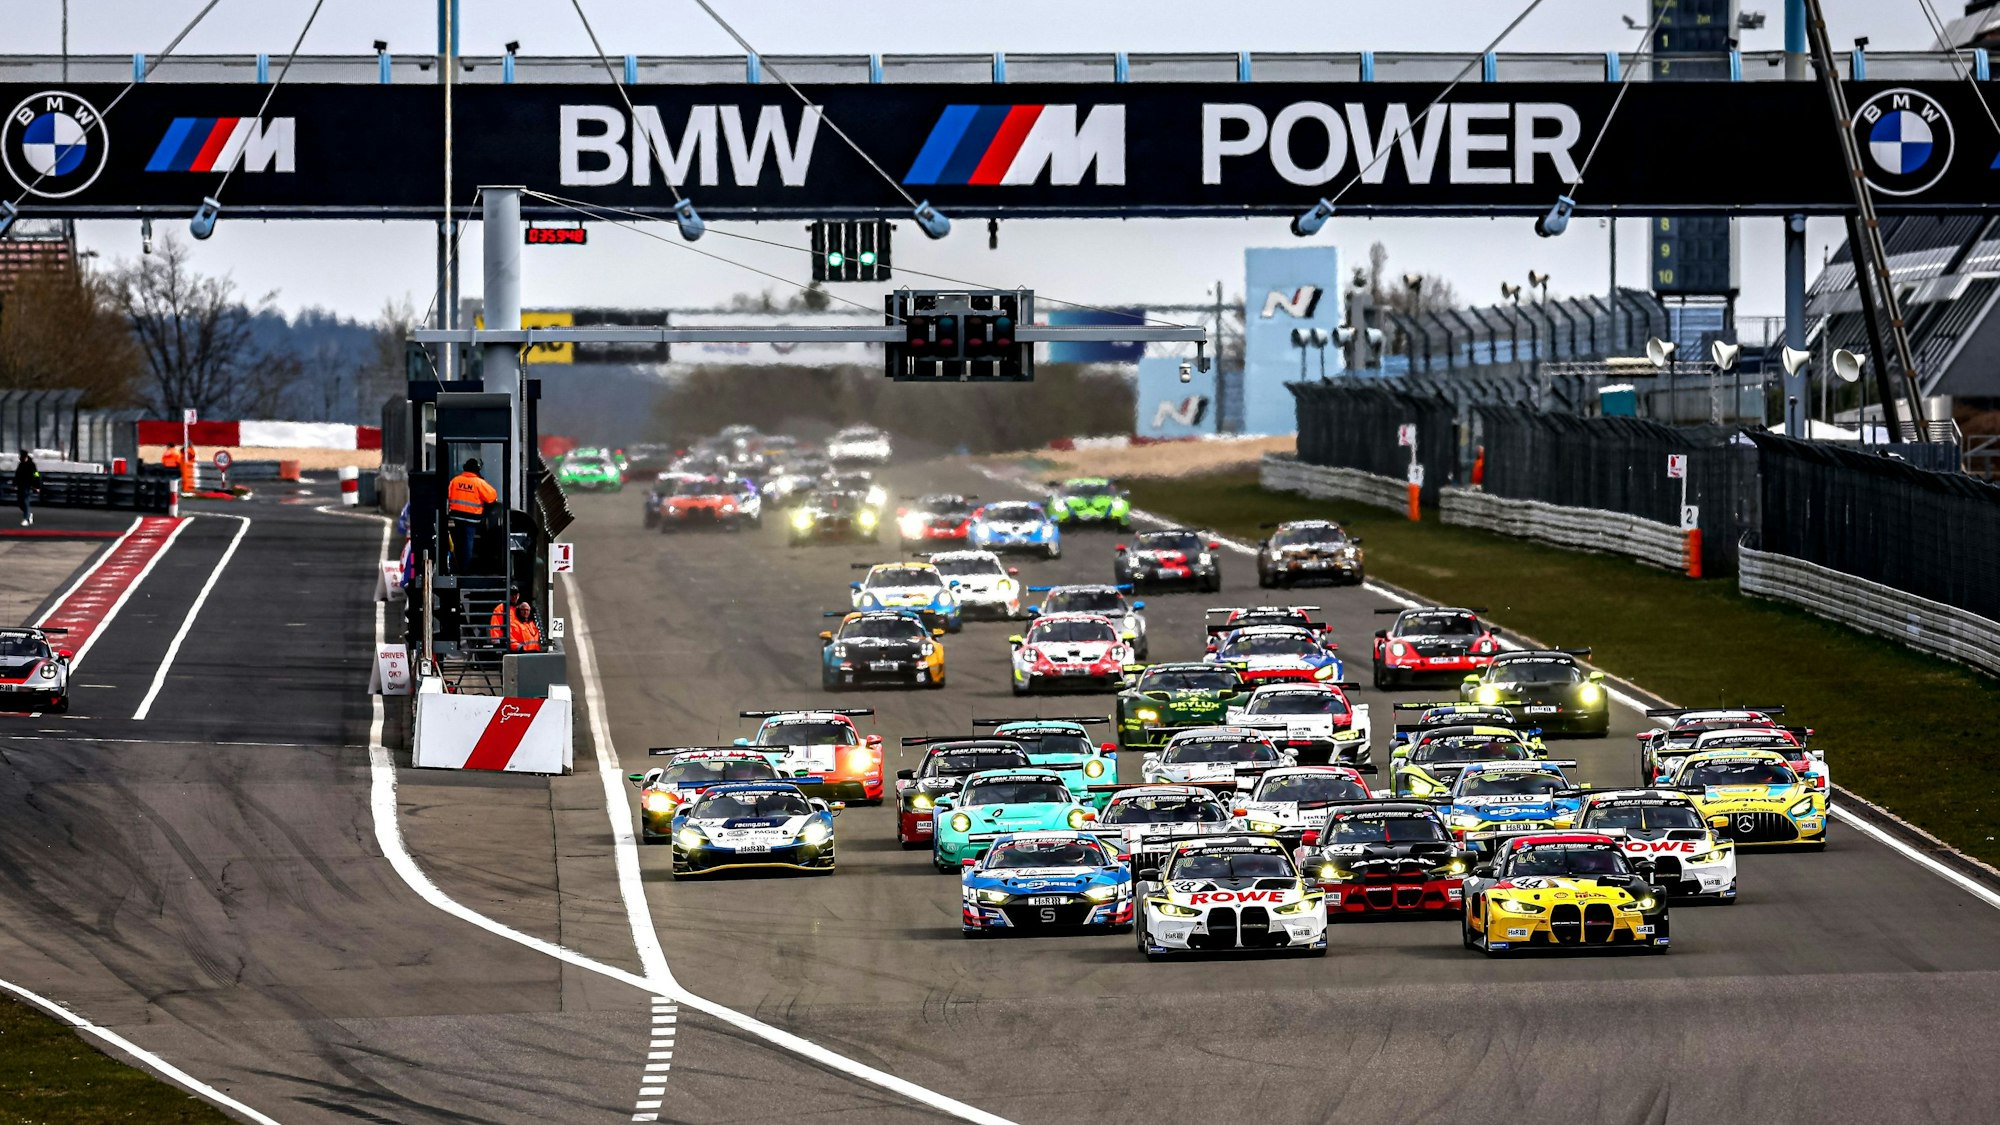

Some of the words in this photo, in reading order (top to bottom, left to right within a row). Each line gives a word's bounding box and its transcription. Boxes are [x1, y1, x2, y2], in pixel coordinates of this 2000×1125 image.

[16, 97, 94, 126] BMW
[1864, 95, 1940, 123] BMW
[560, 104, 823, 187] BMW
[1203, 102, 1582, 185] POWER
[1661, 217, 1670, 232] 8
[1661, 243, 1671, 258] 9
[1658, 269, 1674, 284] 10
[458, 482, 473, 491] VLN
[1686, 507, 1693, 525] 2
[553, 620, 564, 632] 2a
[380, 651, 405, 660] DRIVER
[391, 661, 398, 669] ID
[389, 670, 402, 679] OK?
[1157, 795, 1190, 803] TURISMO
[1202, 847, 1223, 855] GRAN
[1224, 846, 1258, 854] TURISMO
[1334, 843, 1357, 853] 34
[1350, 857, 1437, 869] ADVAN
[1515, 877, 1544, 889] 44
[1034, 897, 1050, 905] H&R
[1190, 891, 1286, 905] ROWE
